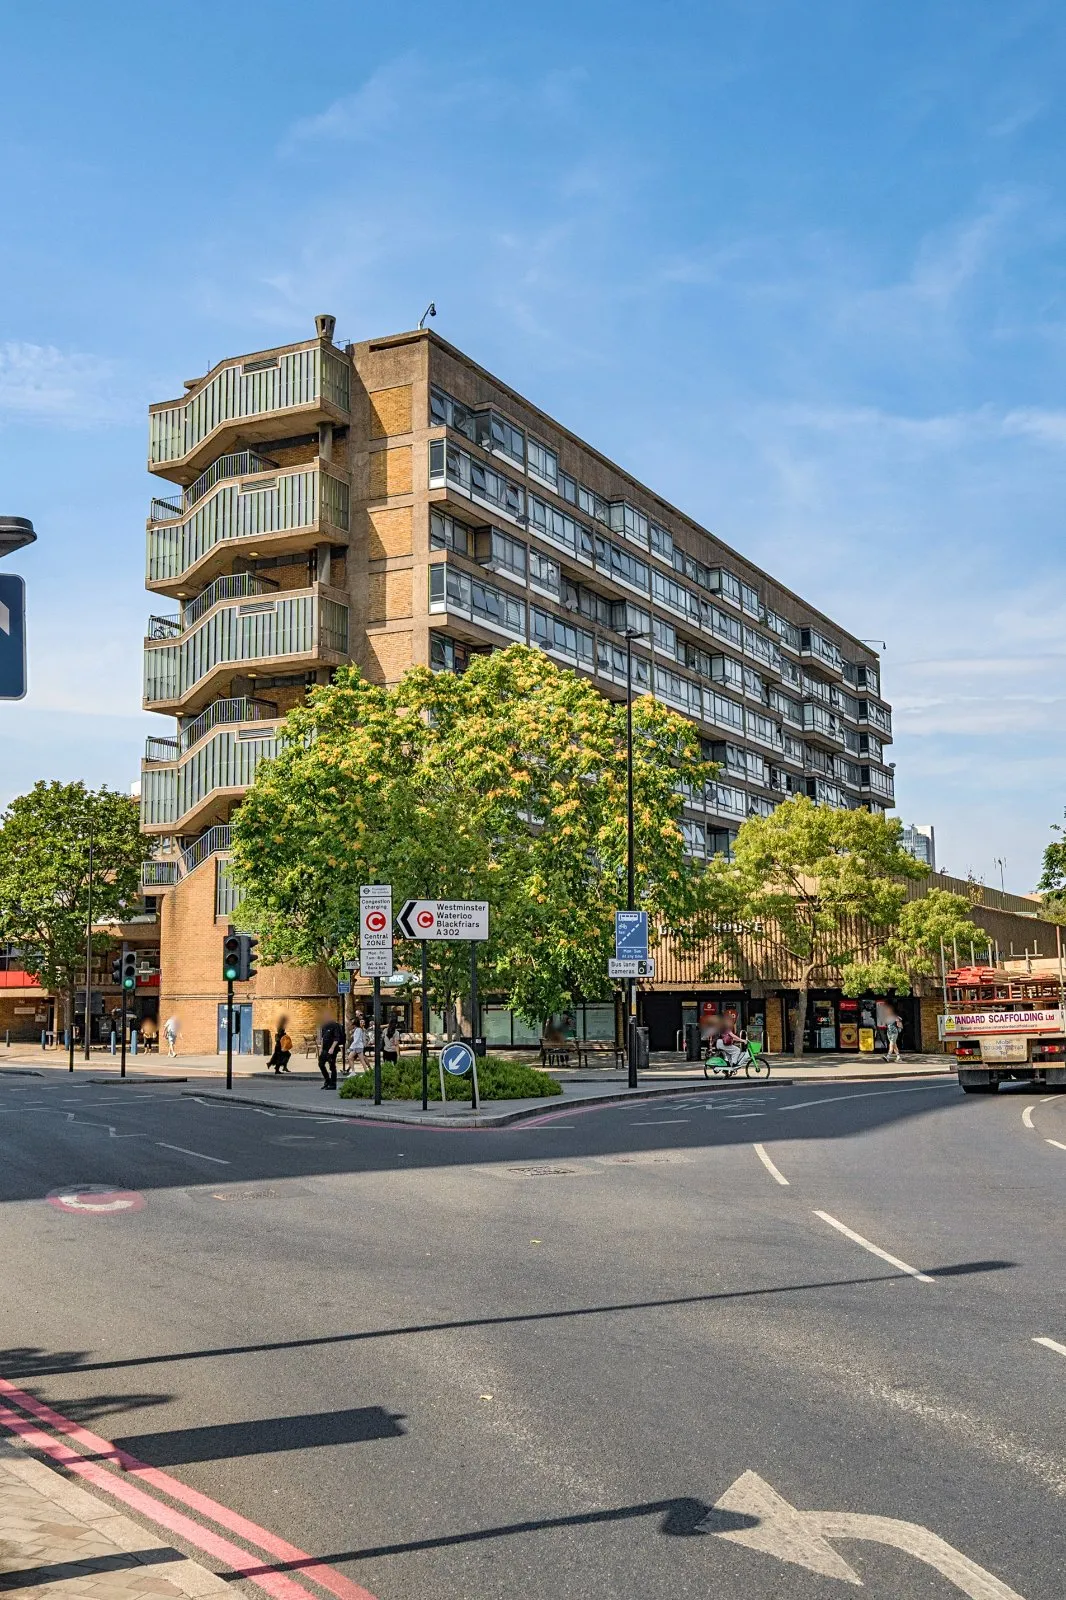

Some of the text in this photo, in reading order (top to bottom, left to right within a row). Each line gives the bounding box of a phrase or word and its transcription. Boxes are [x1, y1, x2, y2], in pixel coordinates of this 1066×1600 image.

[436, 903, 486, 911] Westminster
[436, 920, 480, 928] Blackfriars
[388, 975, 404, 983] NHS
[954, 1015, 985, 1025] TANDARD
[988, 1012, 1044, 1023] SCAFFOLDING
